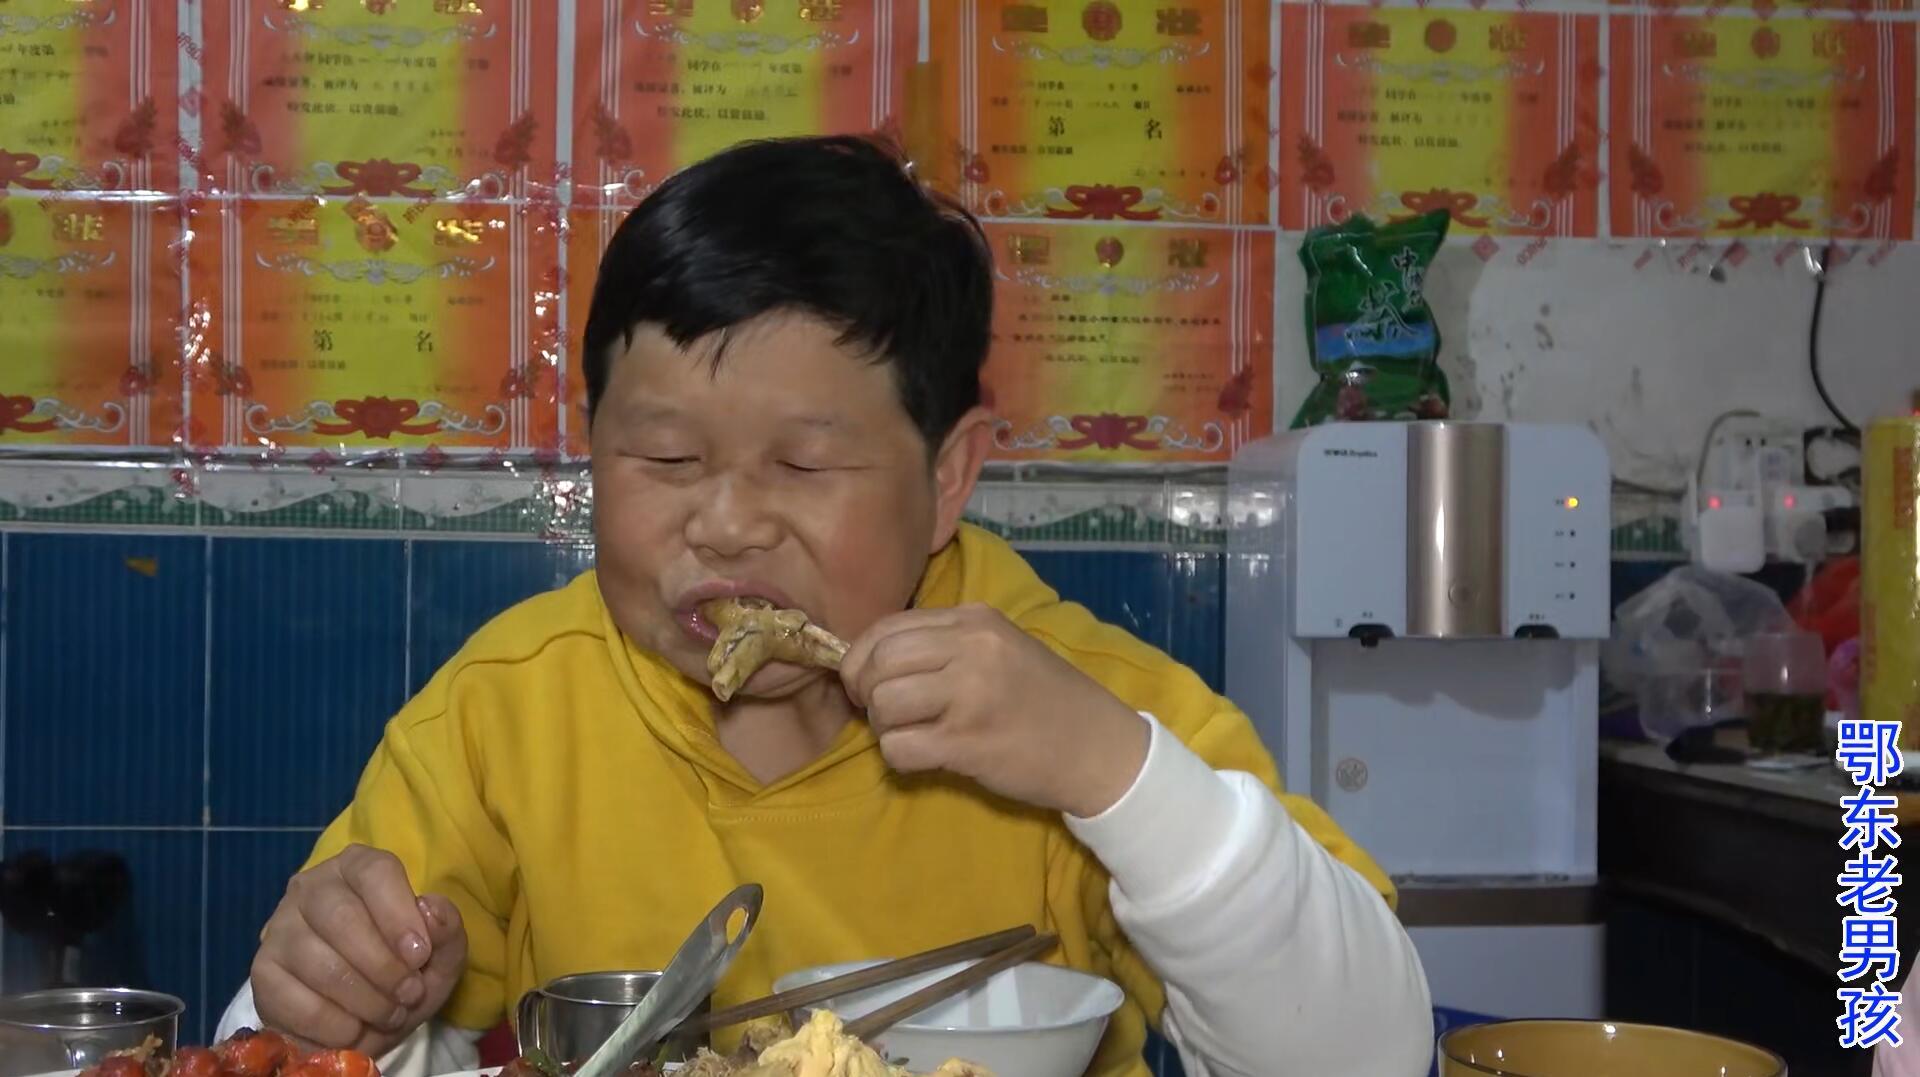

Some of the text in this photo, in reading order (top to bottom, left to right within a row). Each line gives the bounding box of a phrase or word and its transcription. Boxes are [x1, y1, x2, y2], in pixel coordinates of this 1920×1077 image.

[1048, 115, 1163, 140] 第 名
[313, 329, 434, 352] 第 名
